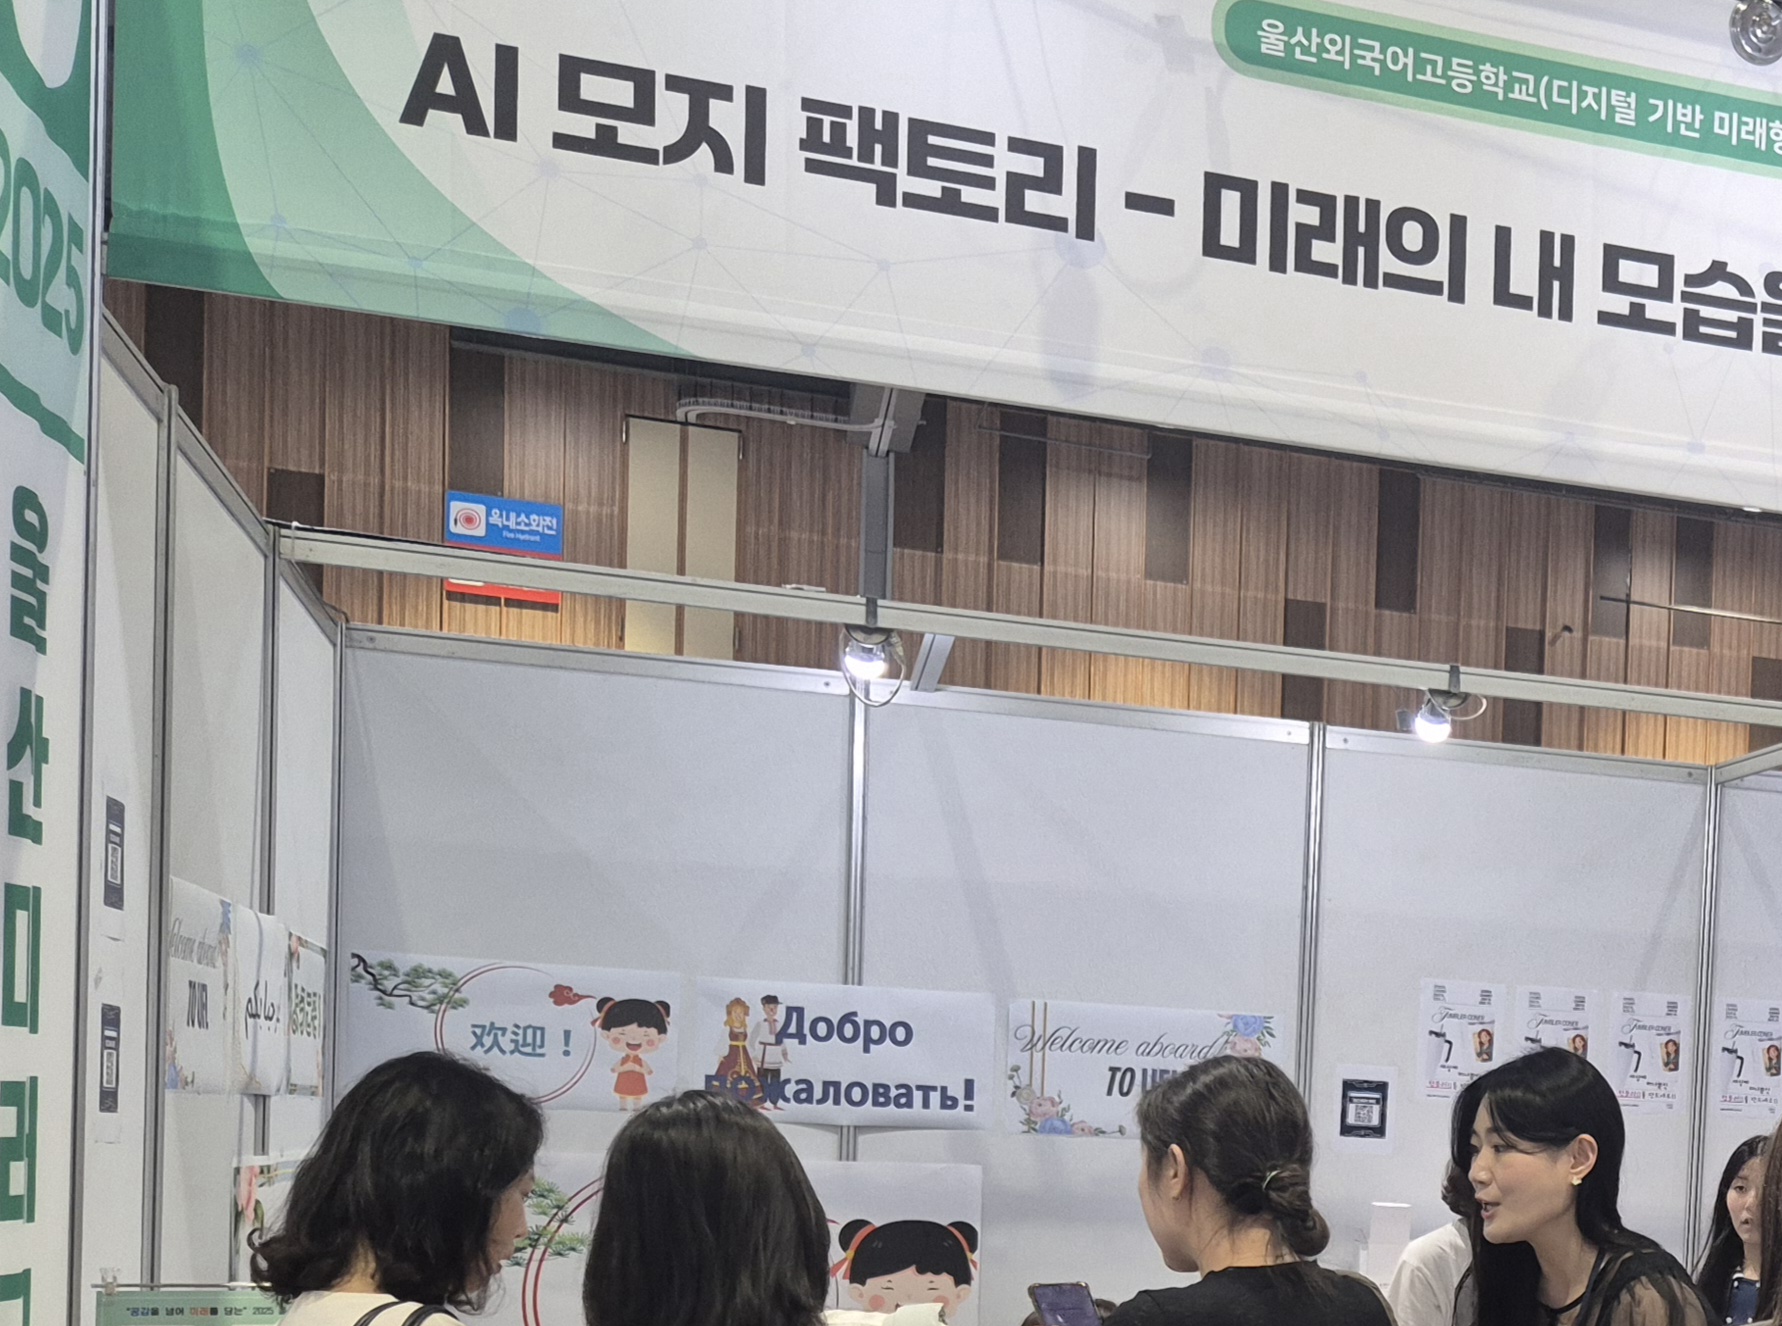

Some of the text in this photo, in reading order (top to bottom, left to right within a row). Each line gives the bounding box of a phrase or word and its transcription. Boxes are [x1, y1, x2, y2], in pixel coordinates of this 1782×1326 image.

[1257, 17, 1637, 128] 울산외국어고등학교(디지털
[1647, 97, 1703, 138] 기반
[400, 33, 518, 141] AI
[553, 54, 766, 185] 모지
[800, 97, 1096, 241] 팩토리
[1203, 172, 1467, 303] 미래의
[1494, 226, 1574, 321] 내
[488, 507, 558, 536] 옥내소화전
[775, 1005, 914, 1054] Добро
[1014, 1024, 1129, 1056] Welcome
[1106, 1066, 1136, 1097] TO
[252, 1307, 274, 1315] 2025
